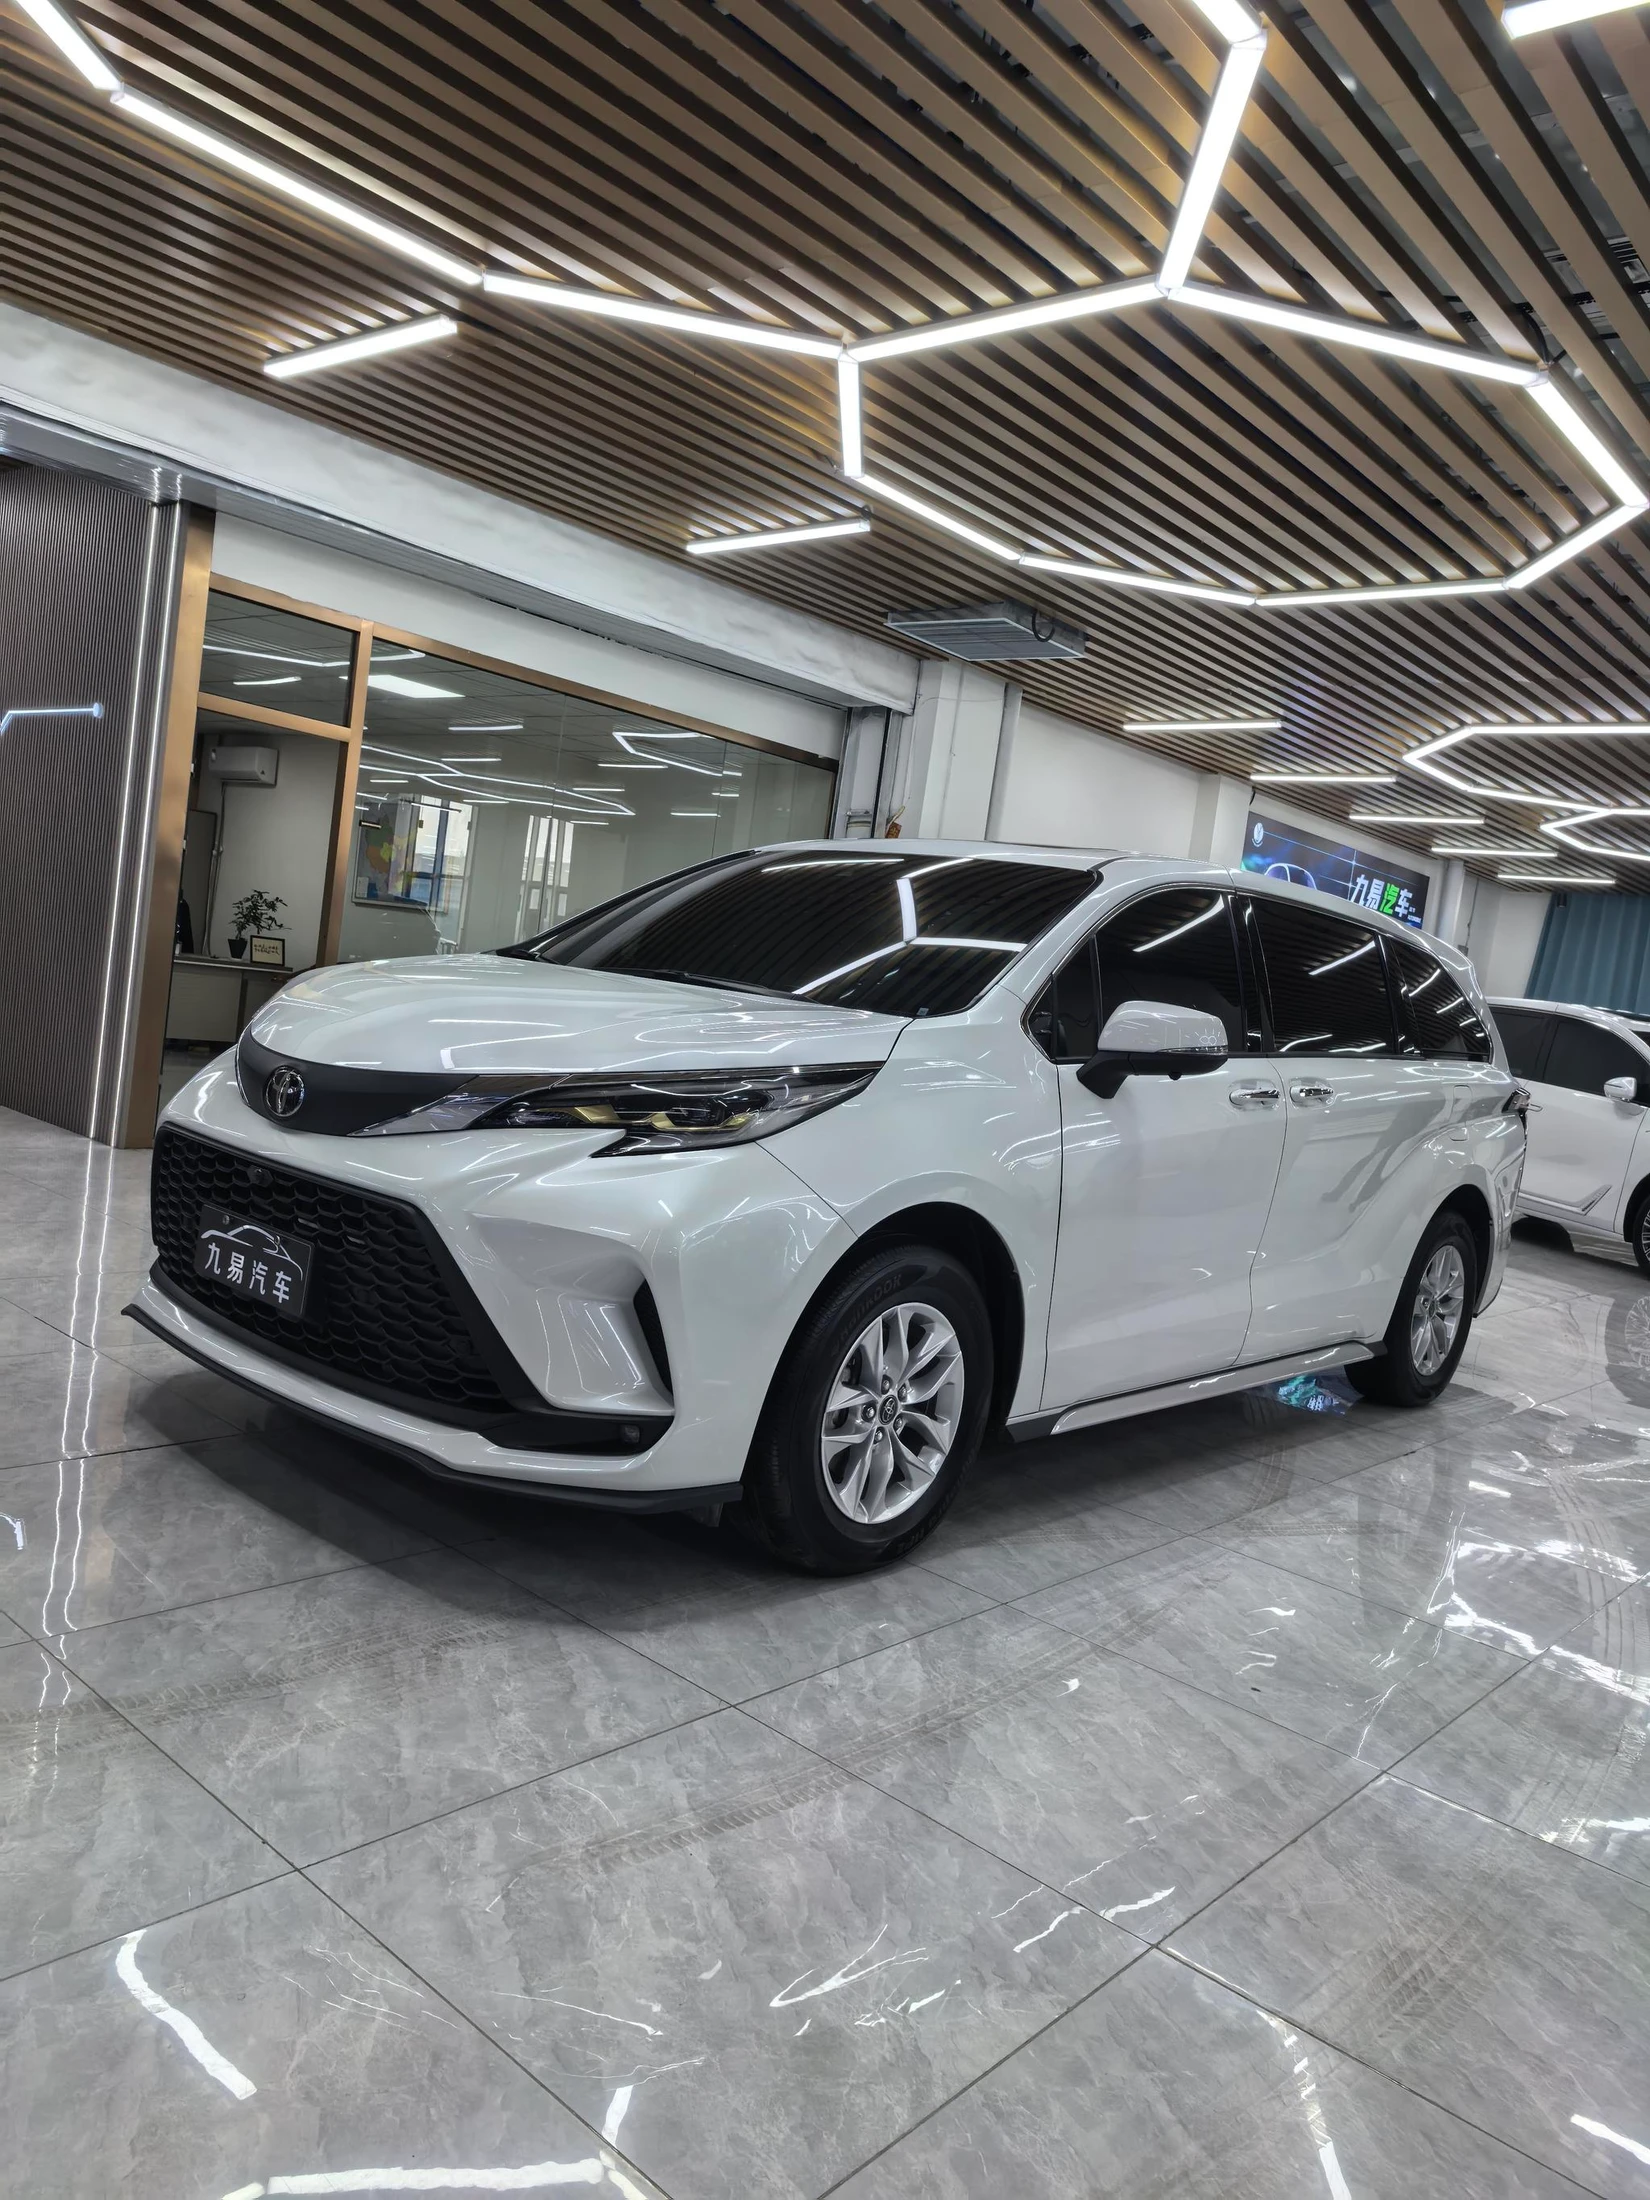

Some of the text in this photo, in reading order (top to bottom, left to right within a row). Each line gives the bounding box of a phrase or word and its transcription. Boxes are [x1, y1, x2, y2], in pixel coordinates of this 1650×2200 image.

[1351, 874, 1413, 918] 九易汽车
[204, 1242, 293, 1304] 九易汽车
